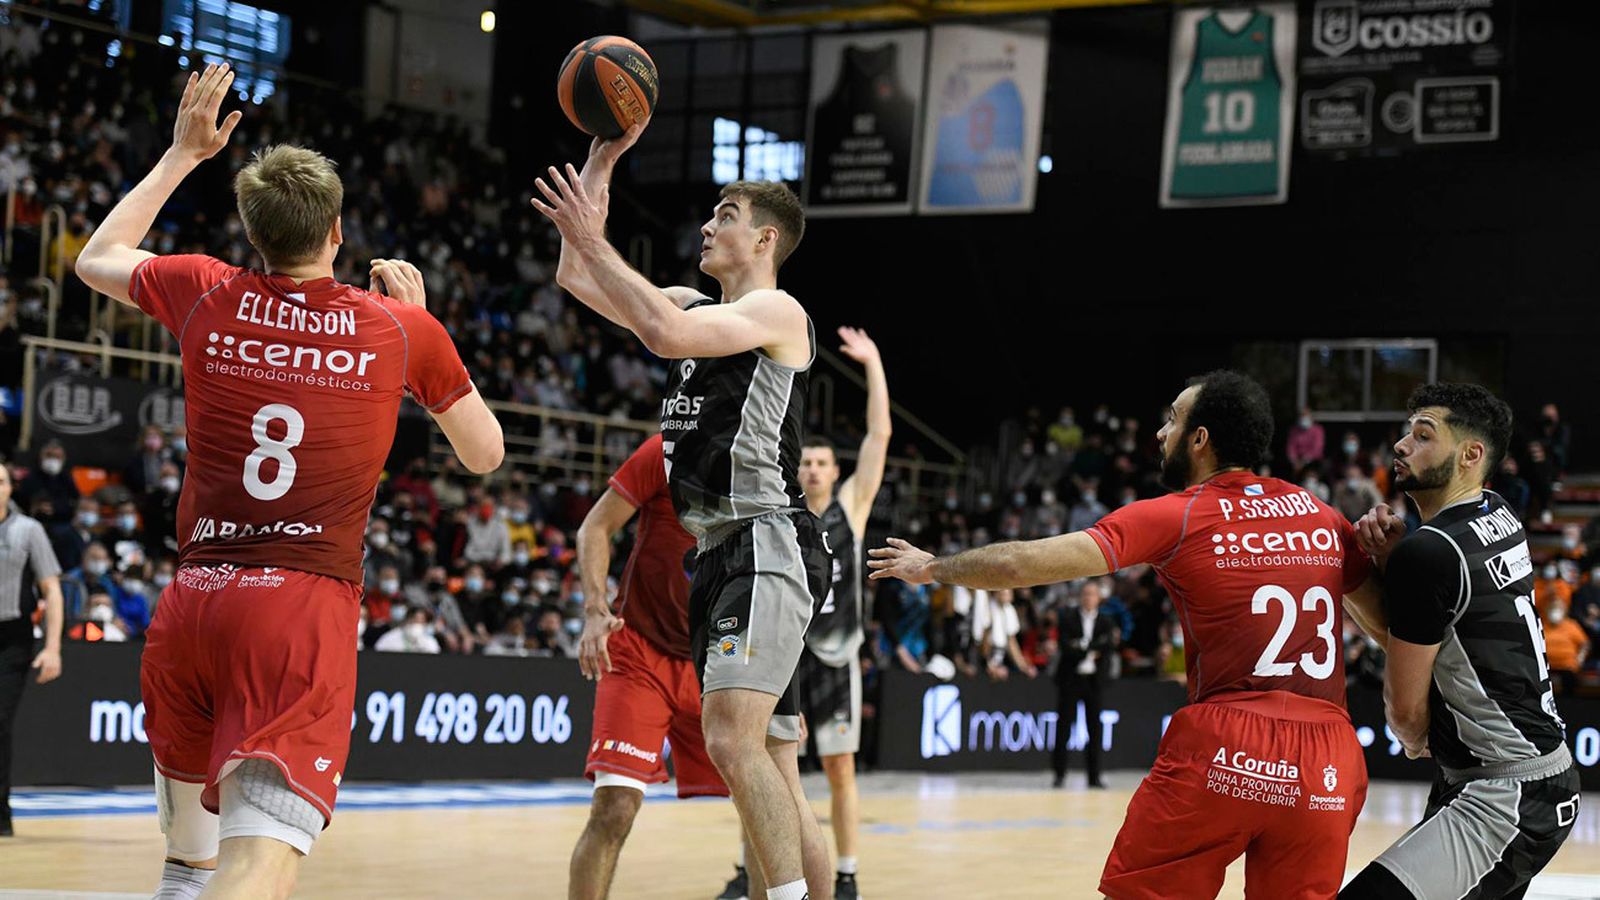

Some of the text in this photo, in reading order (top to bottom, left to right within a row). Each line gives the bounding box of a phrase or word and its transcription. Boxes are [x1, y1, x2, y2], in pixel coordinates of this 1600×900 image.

[1203, 91, 1255, 133] 10
[236, 291, 356, 336] ELLENSON
[206, 361, 372, 391] electrodomésticos
[238, 340, 377, 376] cenor
[243, 403, 304, 500] 8
[1218, 491, 1319, 520] P.SCRUBB
[1251, 584, 1336, 680] 23
[366, 690, 572, 743] 91 498 20 06
[1212, 747, 1299, 779] A Coruña
[1206, 780, 1296, 808] POR DESCUBRIR
[1207, 768, 1302, 797] UNHA PROVINCIA
